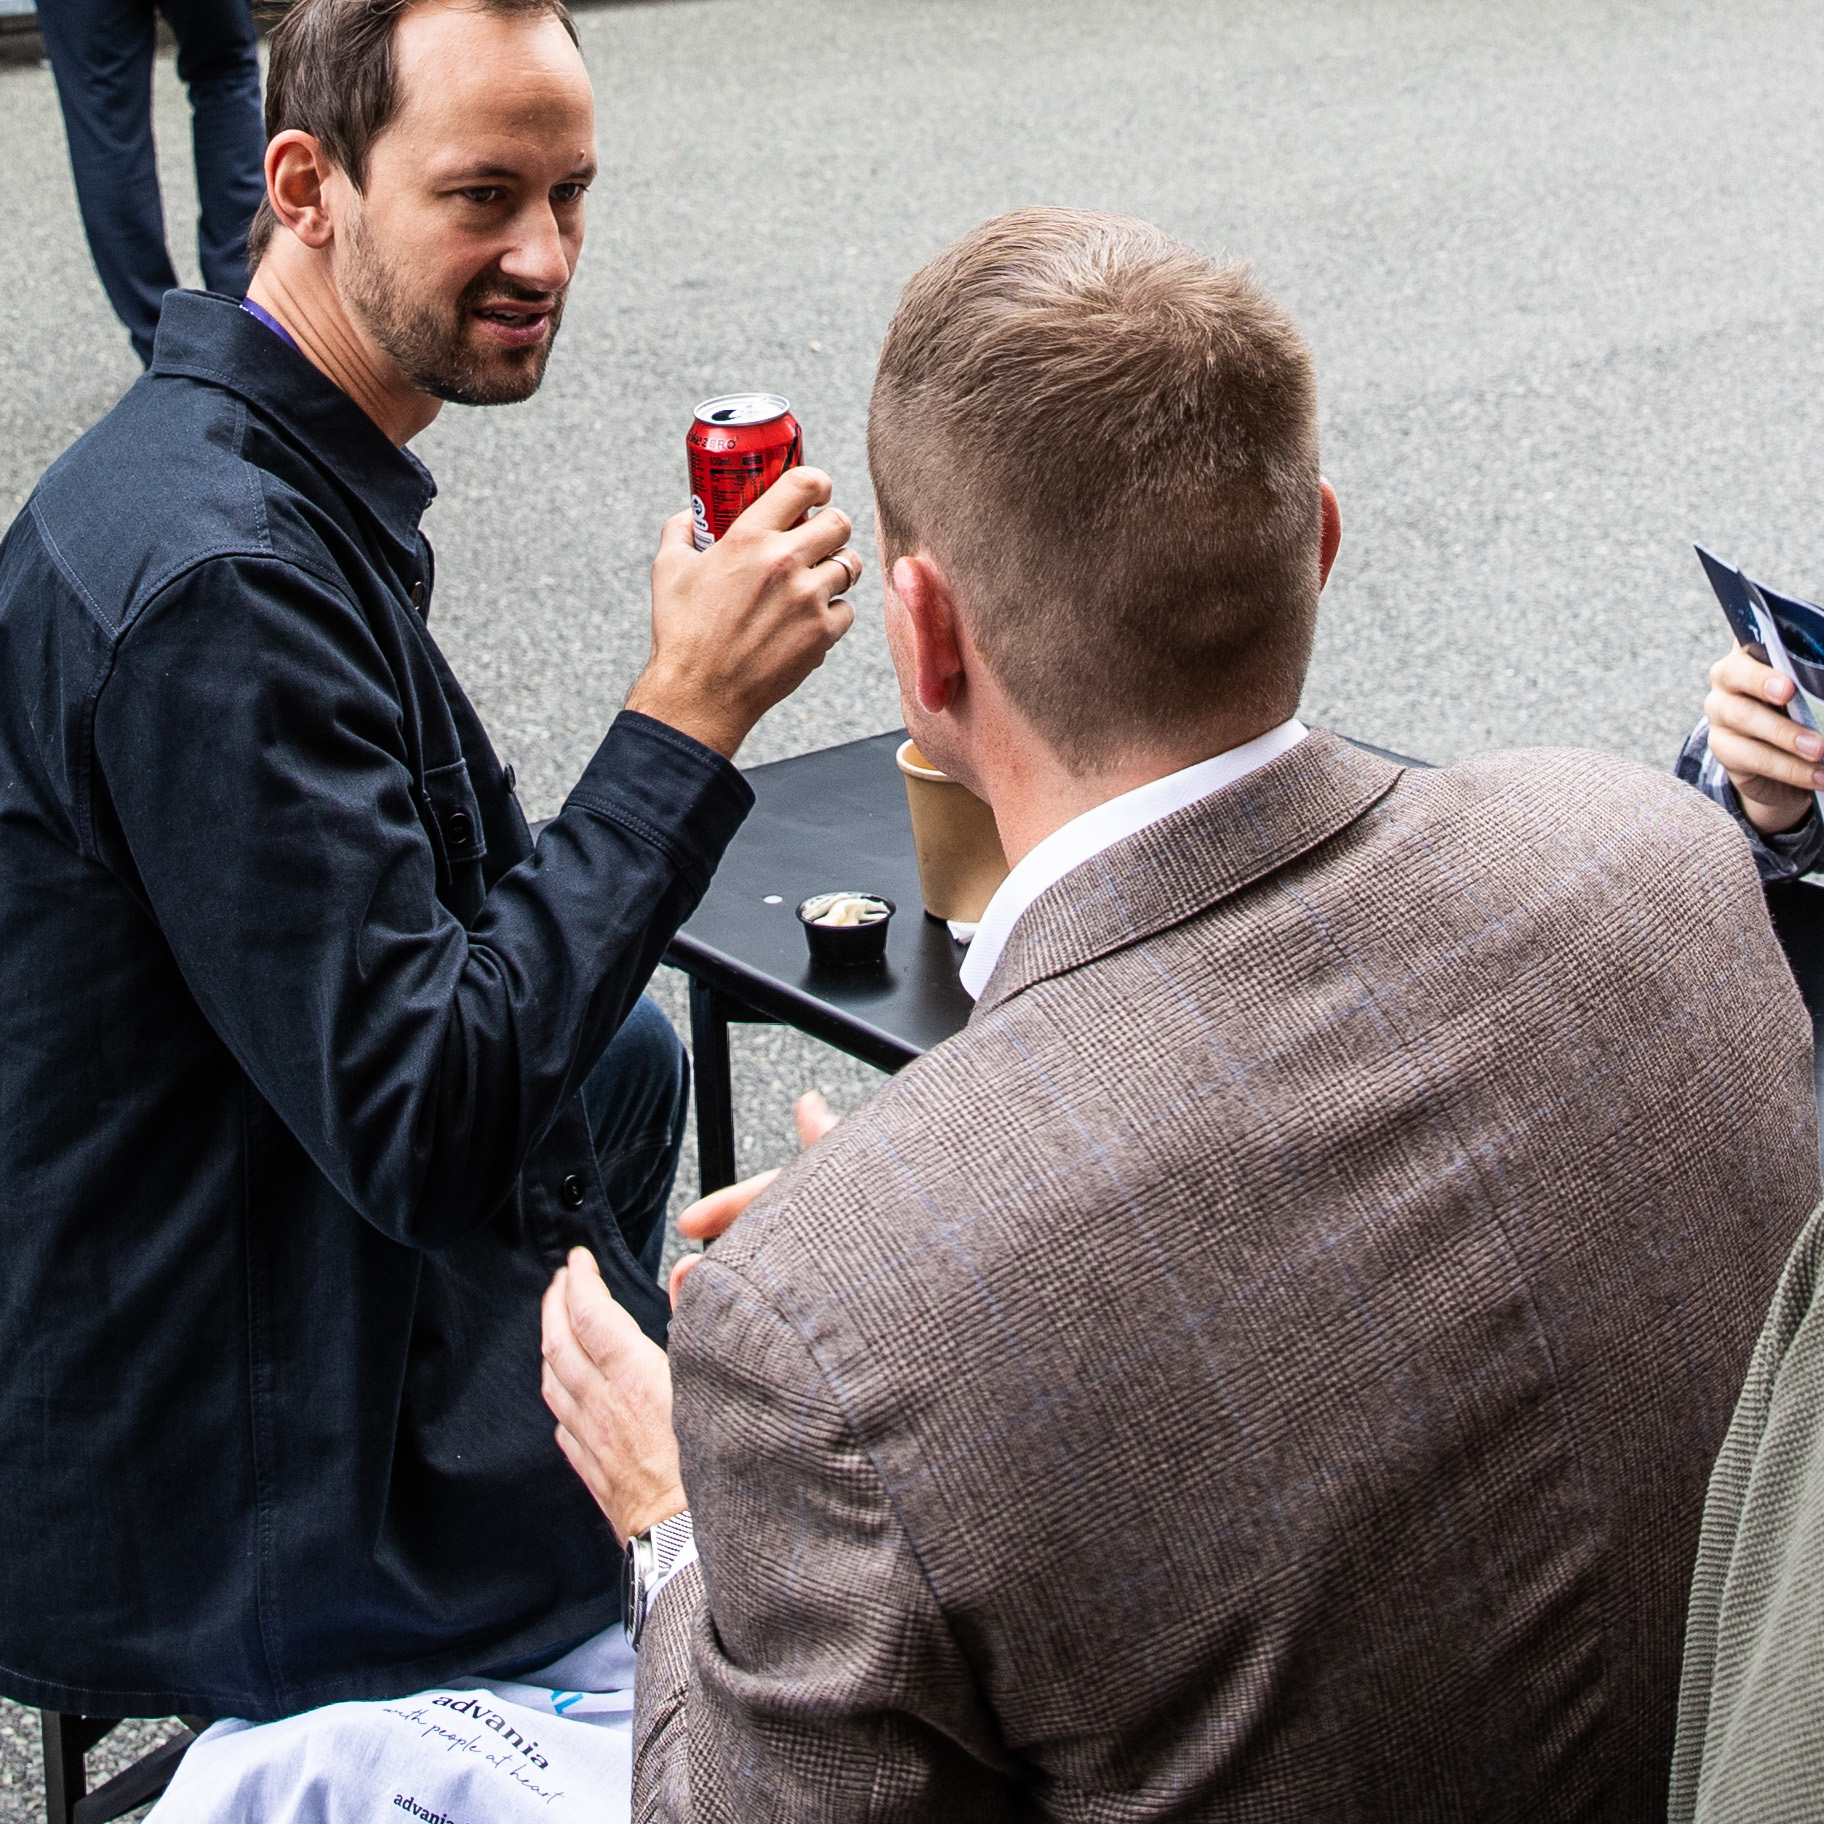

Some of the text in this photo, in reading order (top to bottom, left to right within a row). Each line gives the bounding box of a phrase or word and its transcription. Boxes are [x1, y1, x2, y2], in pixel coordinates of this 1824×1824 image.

[420, 1723, 482, 1753] people
[485, 1754, 513, 1769] at
[509, 1763, 566, 1805] heart
[431, 1695, 549, 1771] advania
